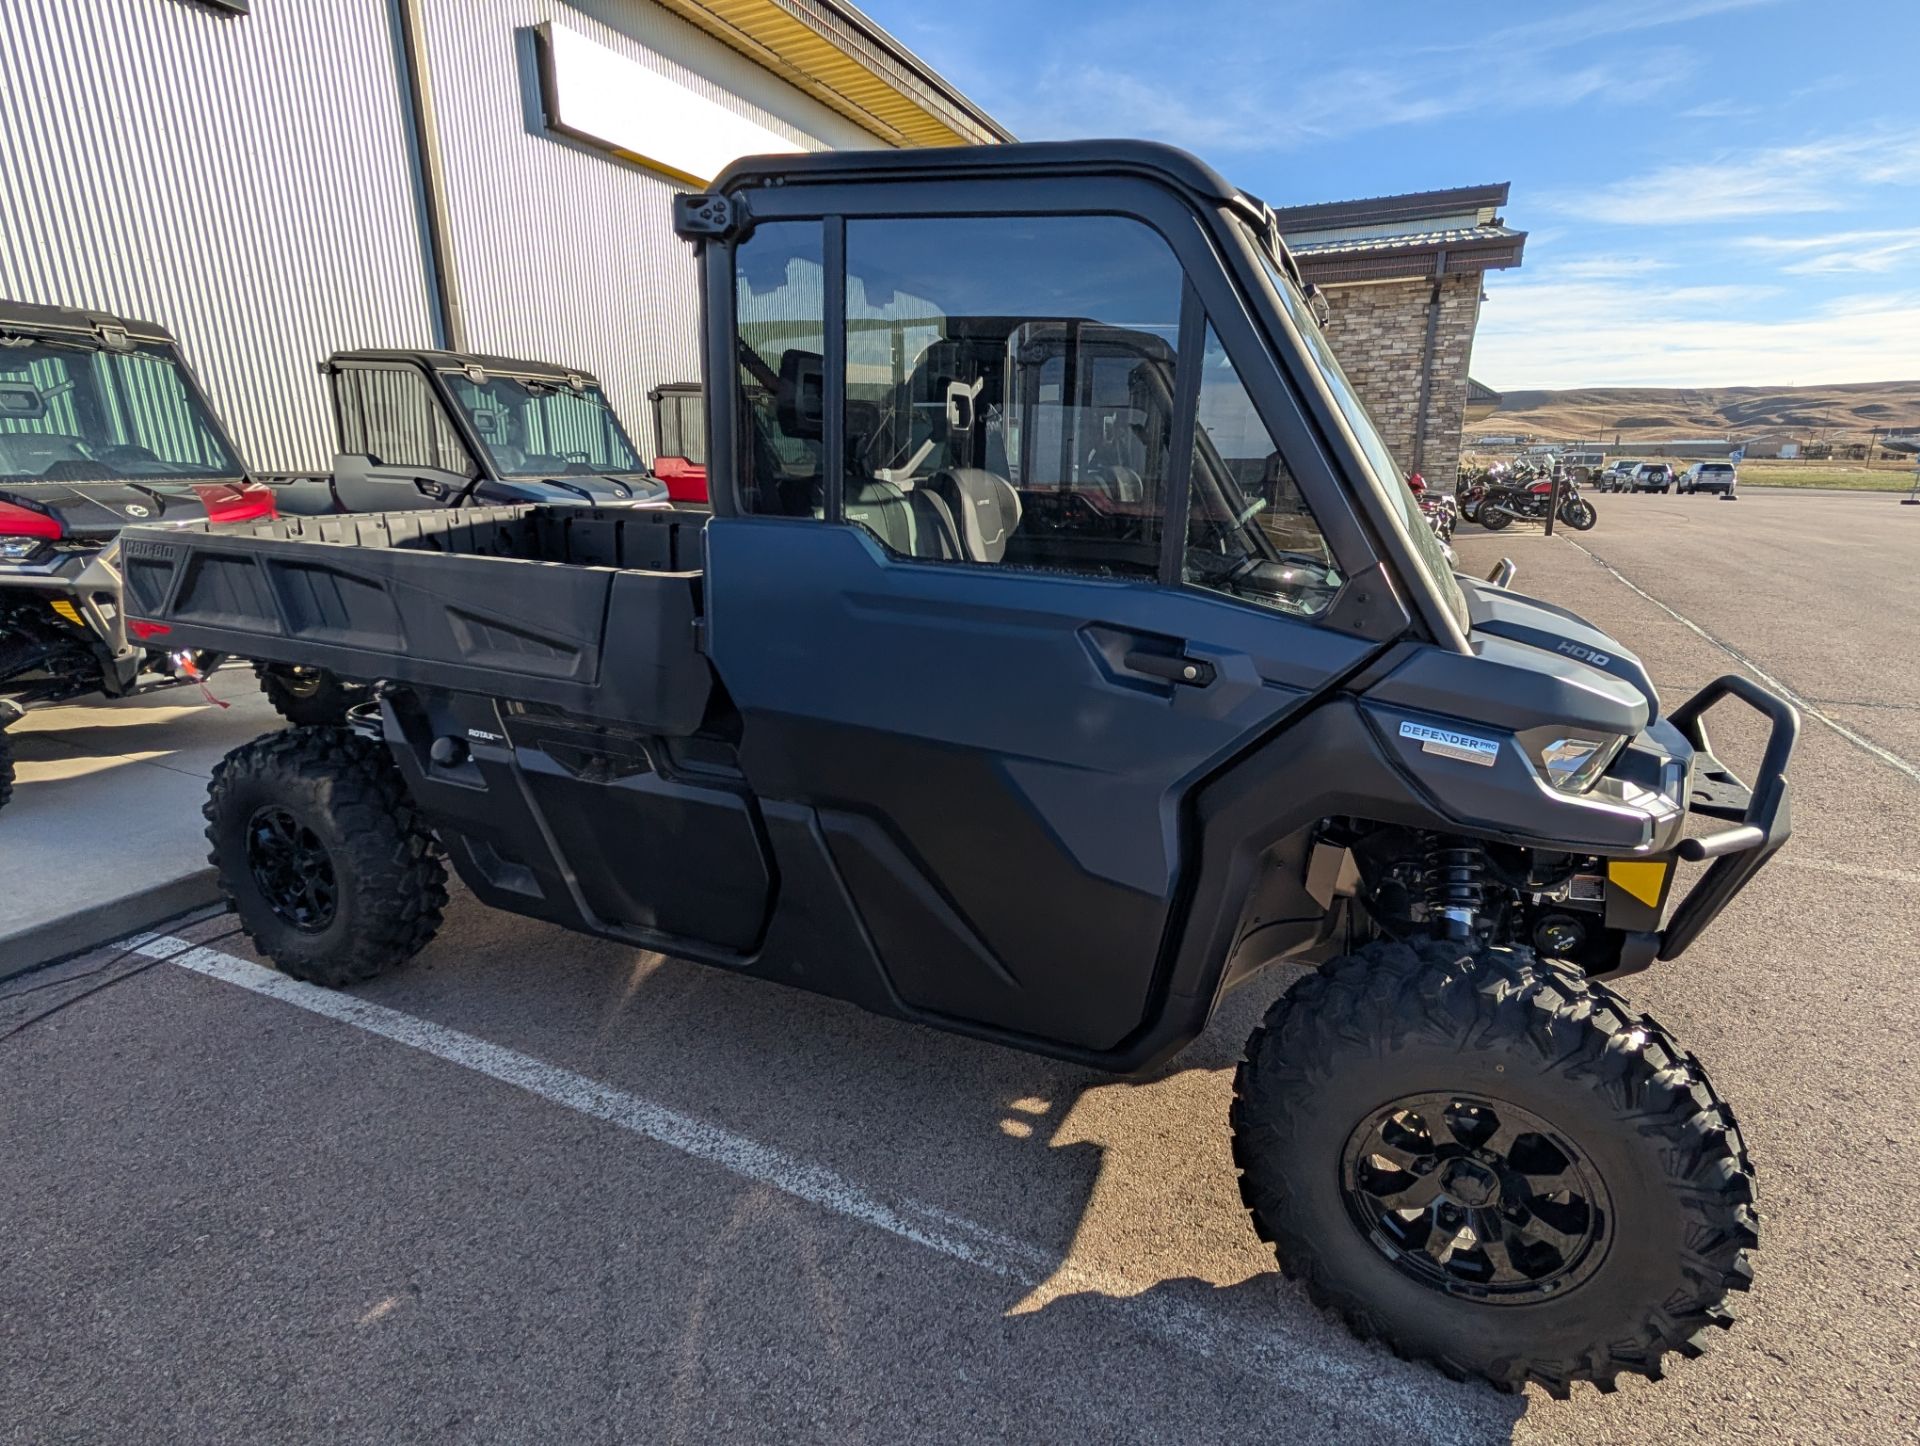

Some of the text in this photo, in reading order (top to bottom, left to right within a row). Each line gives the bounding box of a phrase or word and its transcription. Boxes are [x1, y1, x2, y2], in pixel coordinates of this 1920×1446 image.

[1557, 641, 1610, 666] HD10
[468, 728, 494, 740] ROTAX
[1401, 724, 1497, 750] DEFENDER PRO
